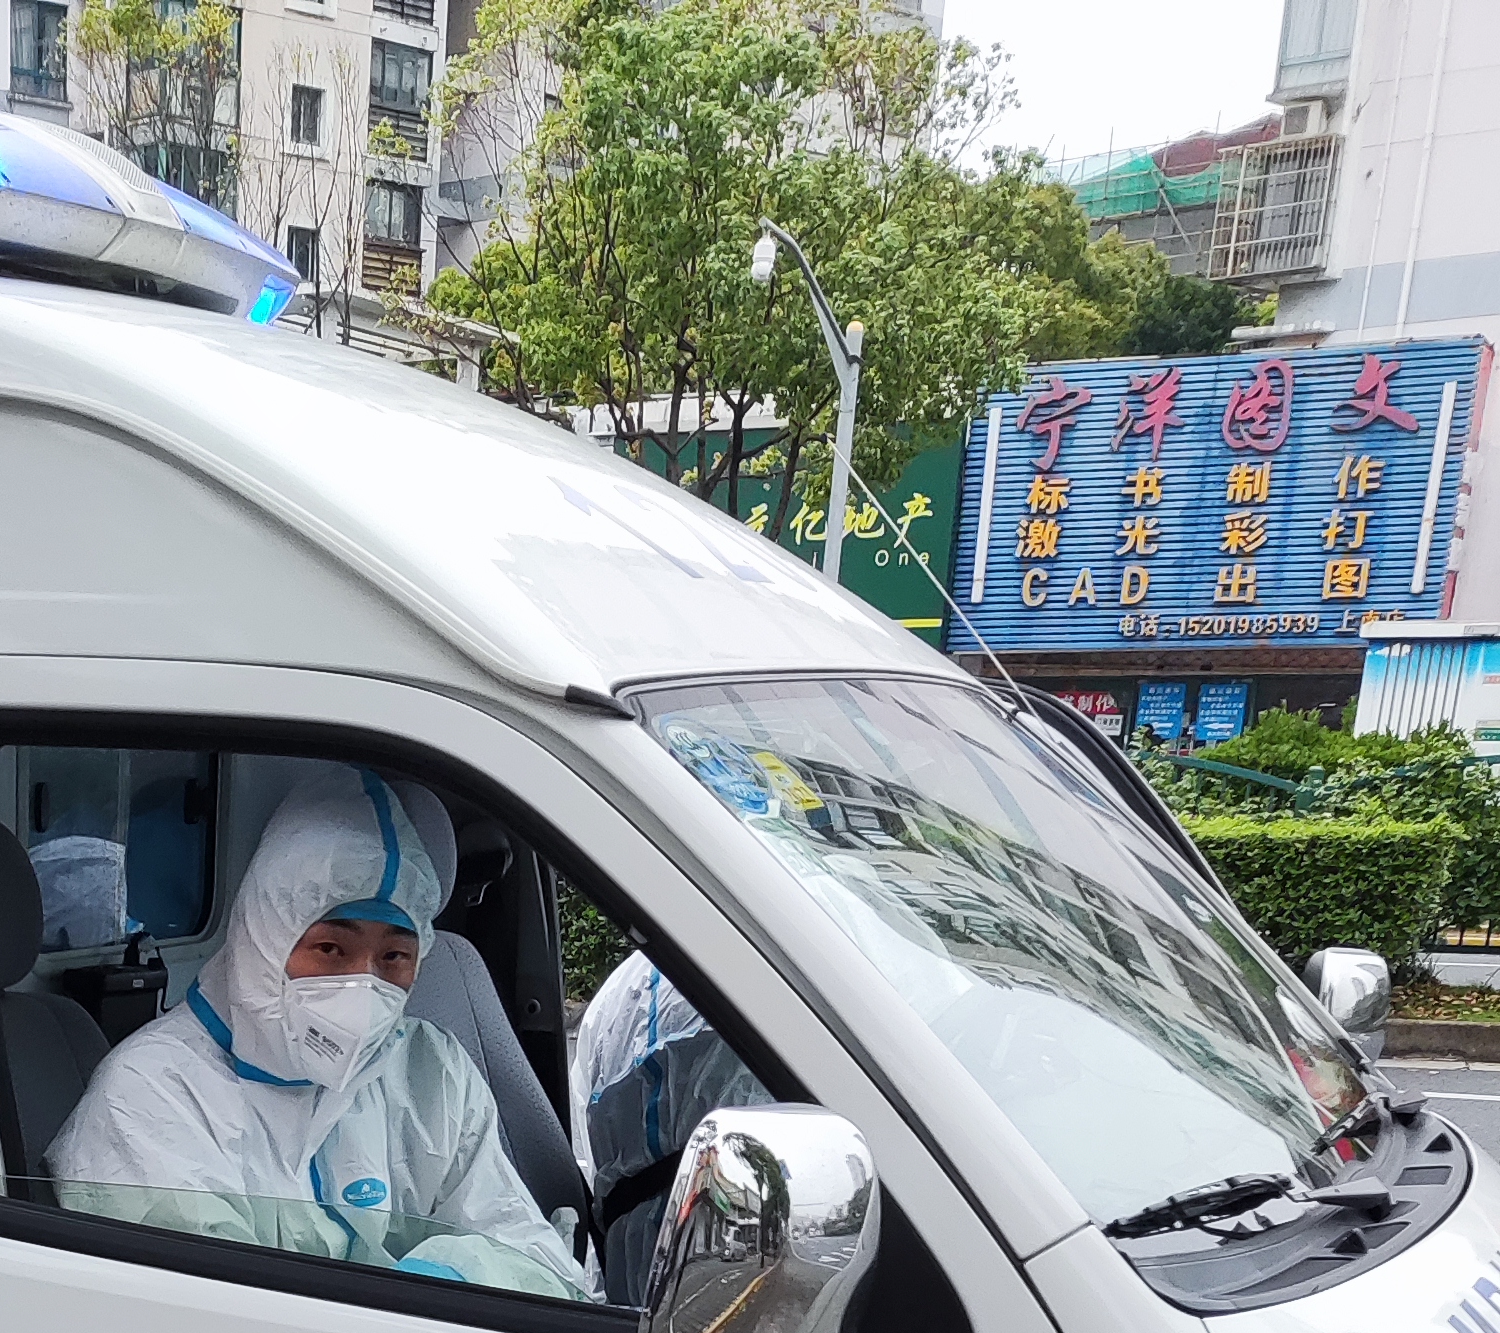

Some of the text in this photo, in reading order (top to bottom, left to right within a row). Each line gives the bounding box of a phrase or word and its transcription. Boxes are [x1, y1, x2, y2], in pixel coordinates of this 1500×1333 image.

[1027, 456, 1386, 514] 标书制作
[874, 549, 930, 567] One
[1015, 509, 1372, 559] 激光彩打
